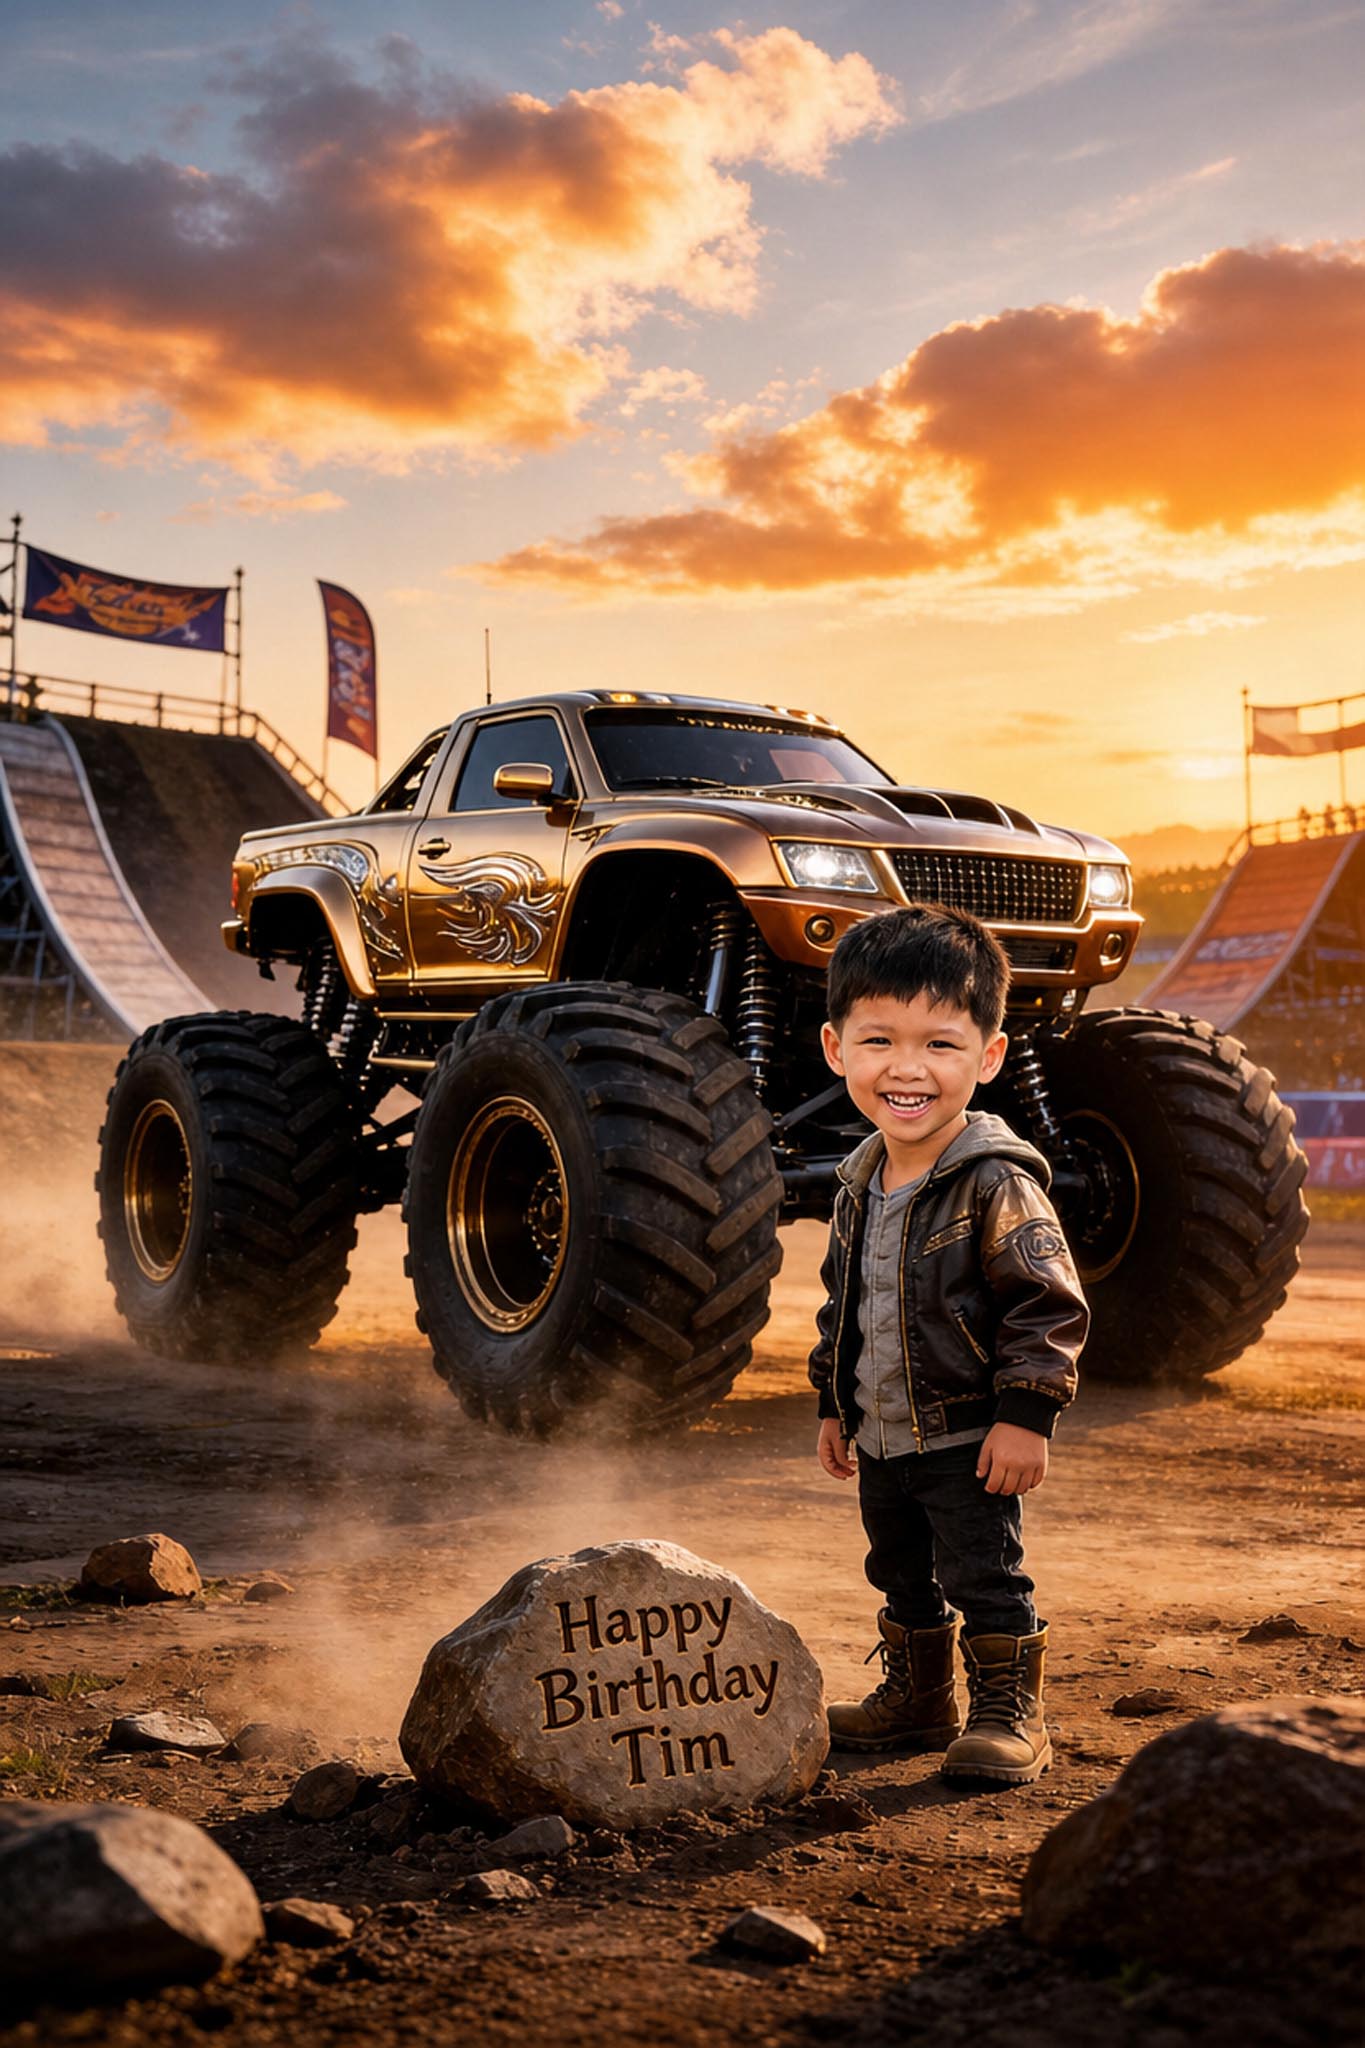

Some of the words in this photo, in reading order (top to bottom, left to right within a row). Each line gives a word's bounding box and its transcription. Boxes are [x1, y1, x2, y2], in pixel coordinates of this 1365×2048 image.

[555, 1595, 732, 1656] Happy
[535, 1653, 779, 1731] Birthday
[611, 1726, 735, 1787] Tim
